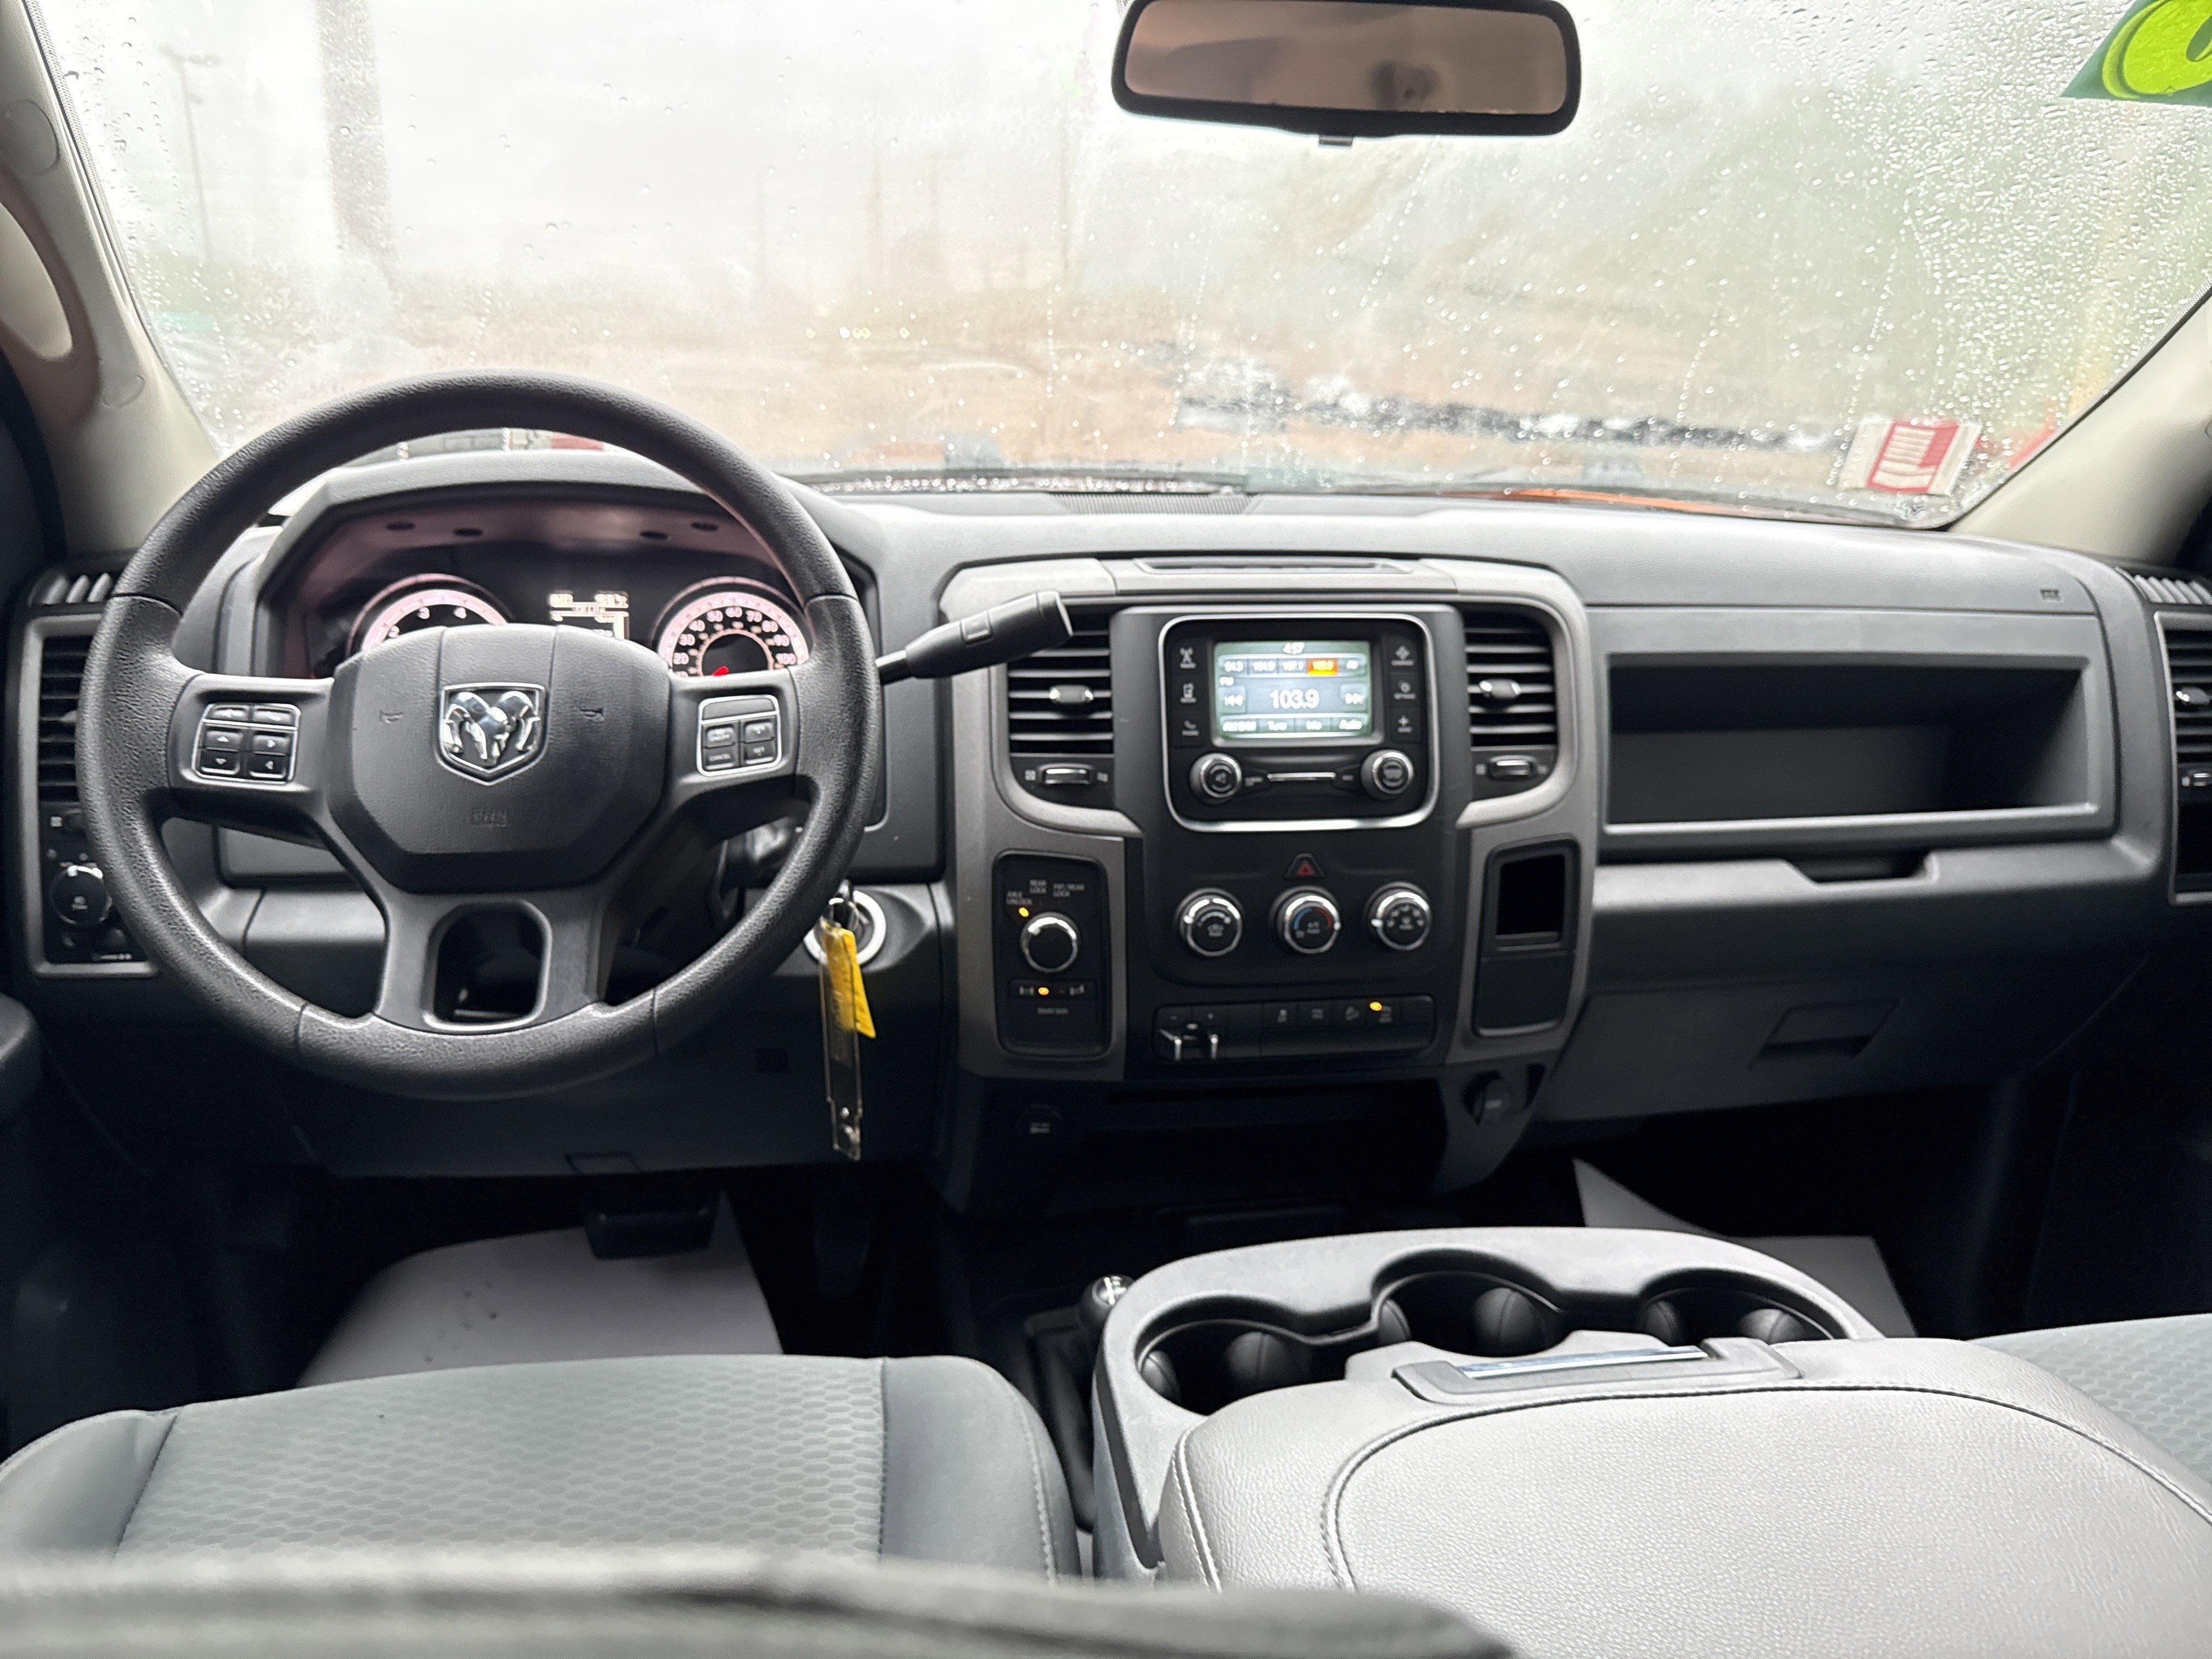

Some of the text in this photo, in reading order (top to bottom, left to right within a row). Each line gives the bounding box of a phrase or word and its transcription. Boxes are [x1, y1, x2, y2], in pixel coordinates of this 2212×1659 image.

[417, 607, 430, 619] 3
[454, 607, 466, 619] 4
[707, 610, 723, 622] 50
[725, 606, 742, 618] 60
[746, 610, 762, 622] 70
[689, 619, 706, 631] 40
[762, 620, 778, 632] 80
[388, 625, 400, 638] 2
[679, 634, 695, 646] 30
[774, 634, 790, 646] 90
[673, 652, 689, 665] 20
[776, 653, 796, 665] 100
[1269, 689, 1320, 709] 103.9
